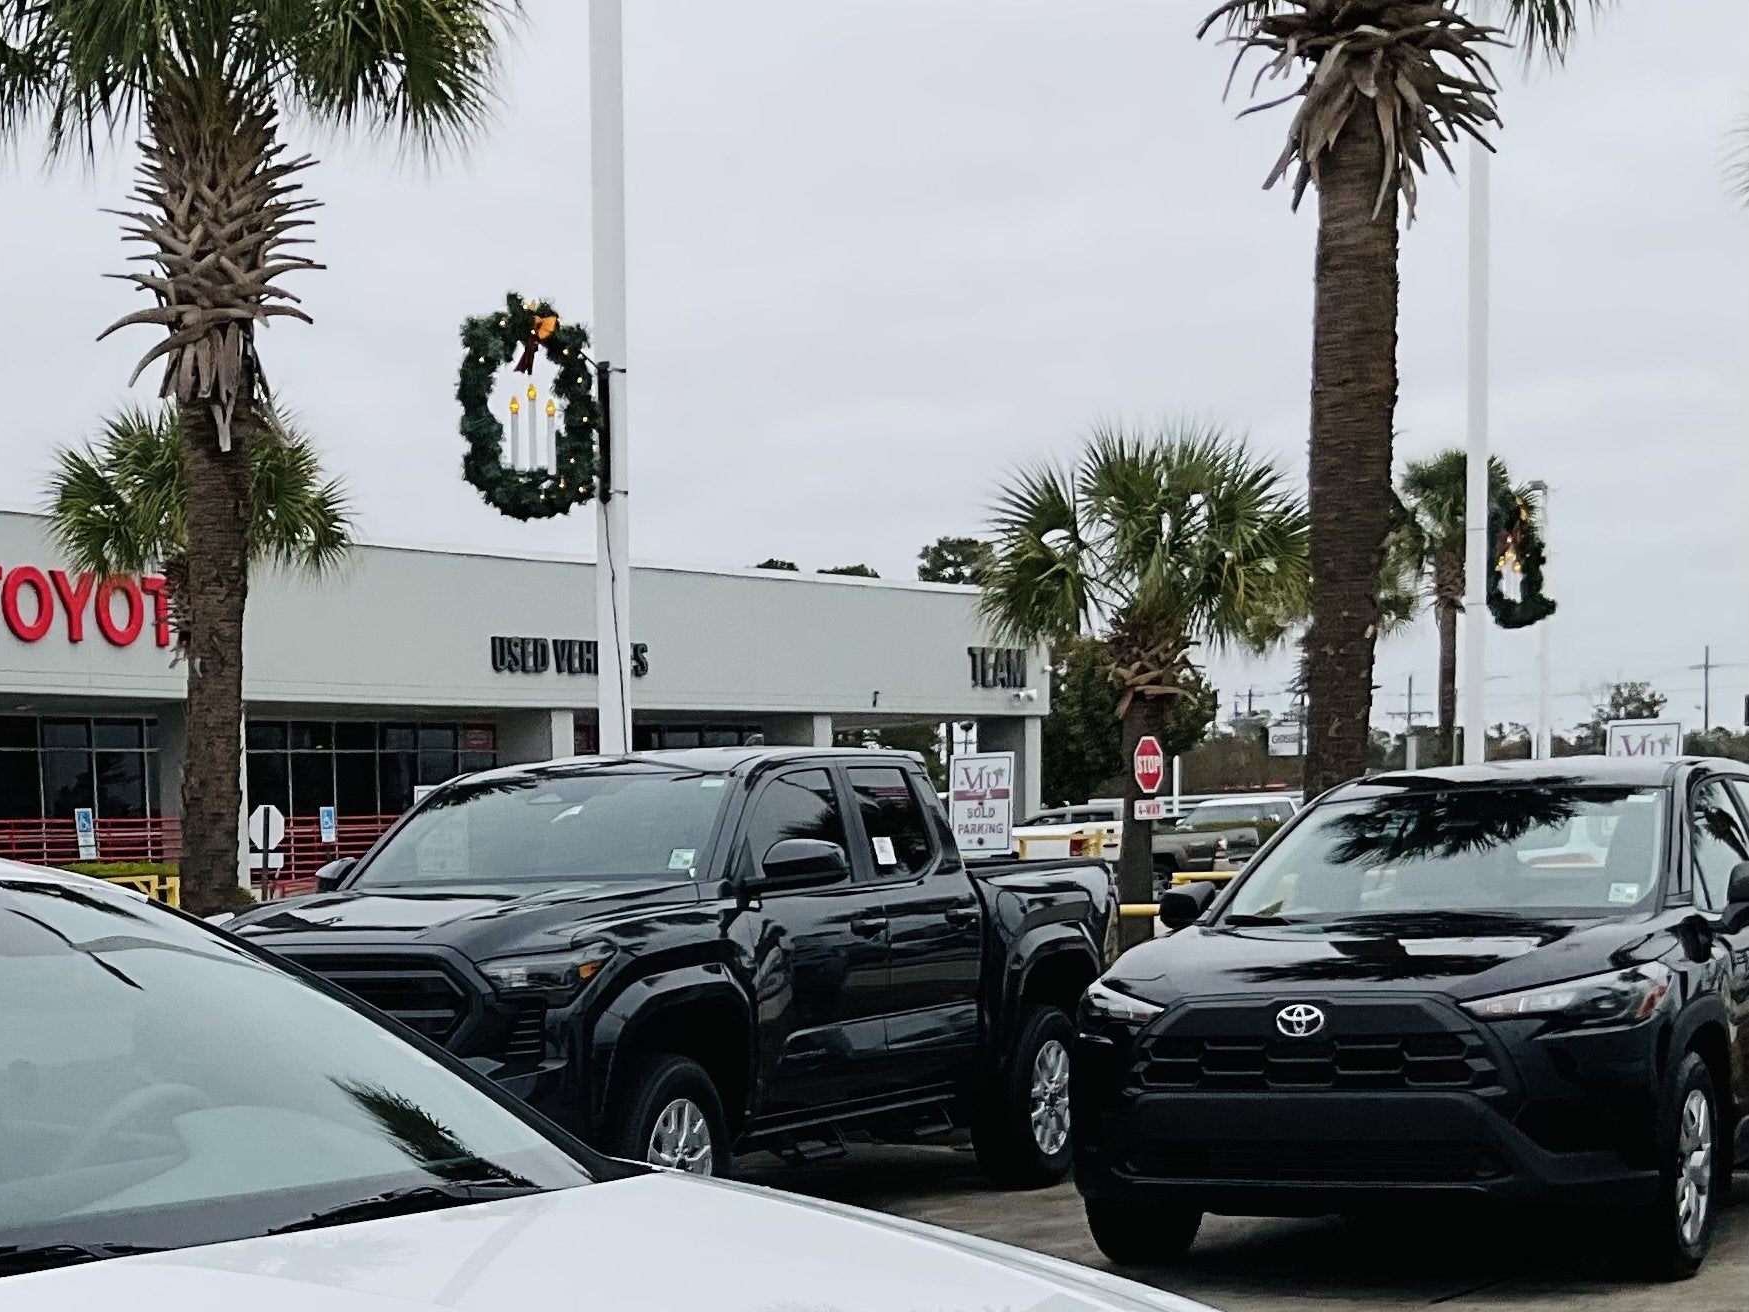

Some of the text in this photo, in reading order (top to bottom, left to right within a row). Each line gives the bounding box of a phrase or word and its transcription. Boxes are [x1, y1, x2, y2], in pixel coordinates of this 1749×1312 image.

[490, 635, 649, 678] USED VEHS
[967, 646, 1027, 688] TEAM
[1137, 755, 1161, 774] STOP
[966, 807, 996, 819] SOLD
[957, 823, 1004, 836] PARKING
